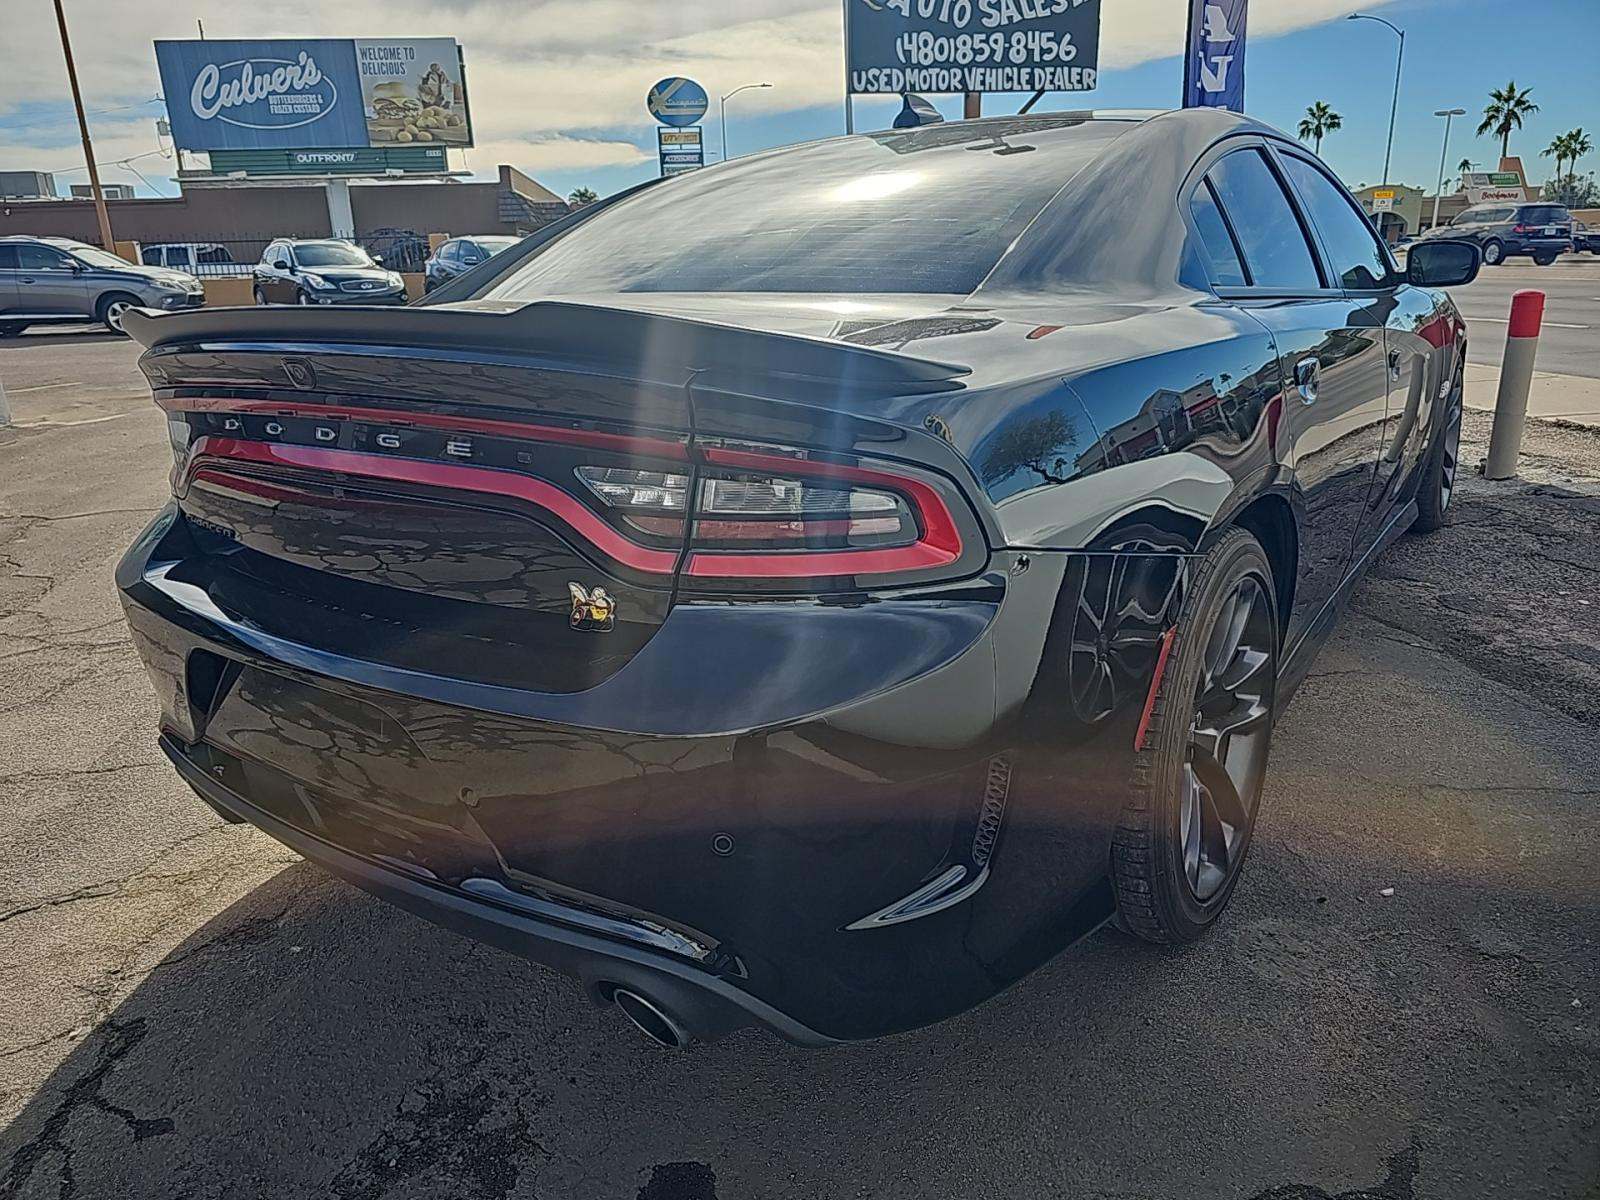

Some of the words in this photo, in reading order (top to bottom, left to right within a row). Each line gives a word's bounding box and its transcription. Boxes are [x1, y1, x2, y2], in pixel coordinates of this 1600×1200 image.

[360, 47, 401, 60] WELCOME
[403, 47, 415, 60] TO
[362, 62, 406, 75] DELICIOUS
[852, 67, 904, 93] USED
[905, 67, 963, 91] MOTOR
[964, 66, 1031, 91] VEHICLE
[1034, 67, 1096, 90] DEALER
[191, 51, 321, 119] Culver's
[224, 417, 473, 458] DODGE
